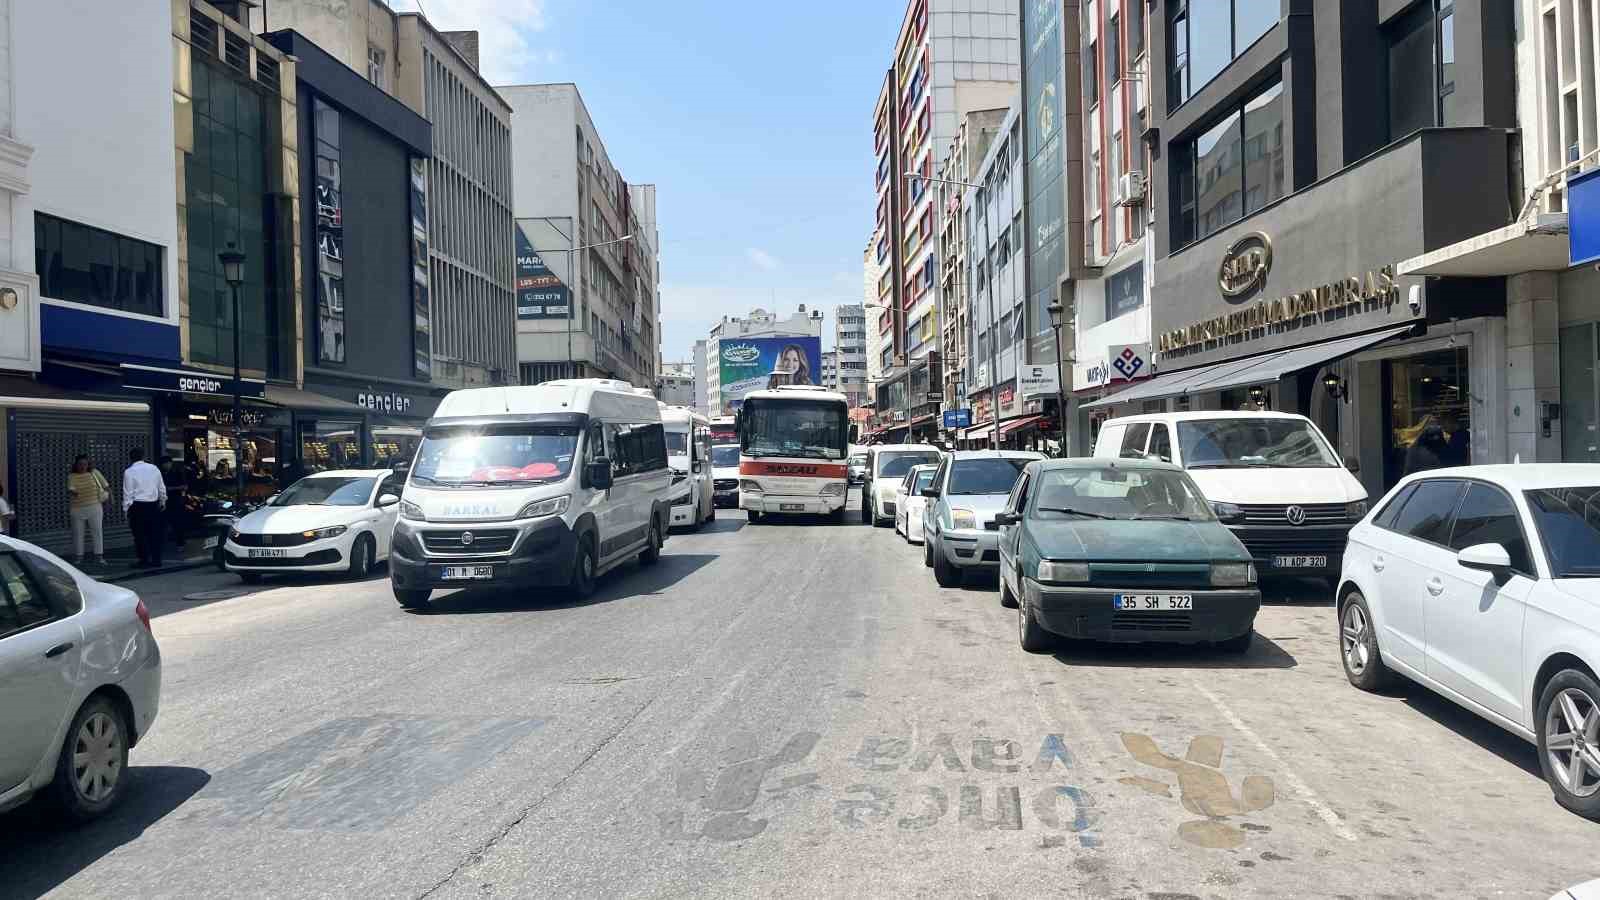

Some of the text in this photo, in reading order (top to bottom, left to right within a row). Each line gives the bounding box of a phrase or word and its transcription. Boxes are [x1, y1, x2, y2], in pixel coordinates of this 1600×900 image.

[179, 377, 222, 393] gençler
[1123, 595, 1191, 609] 35 SH 522
